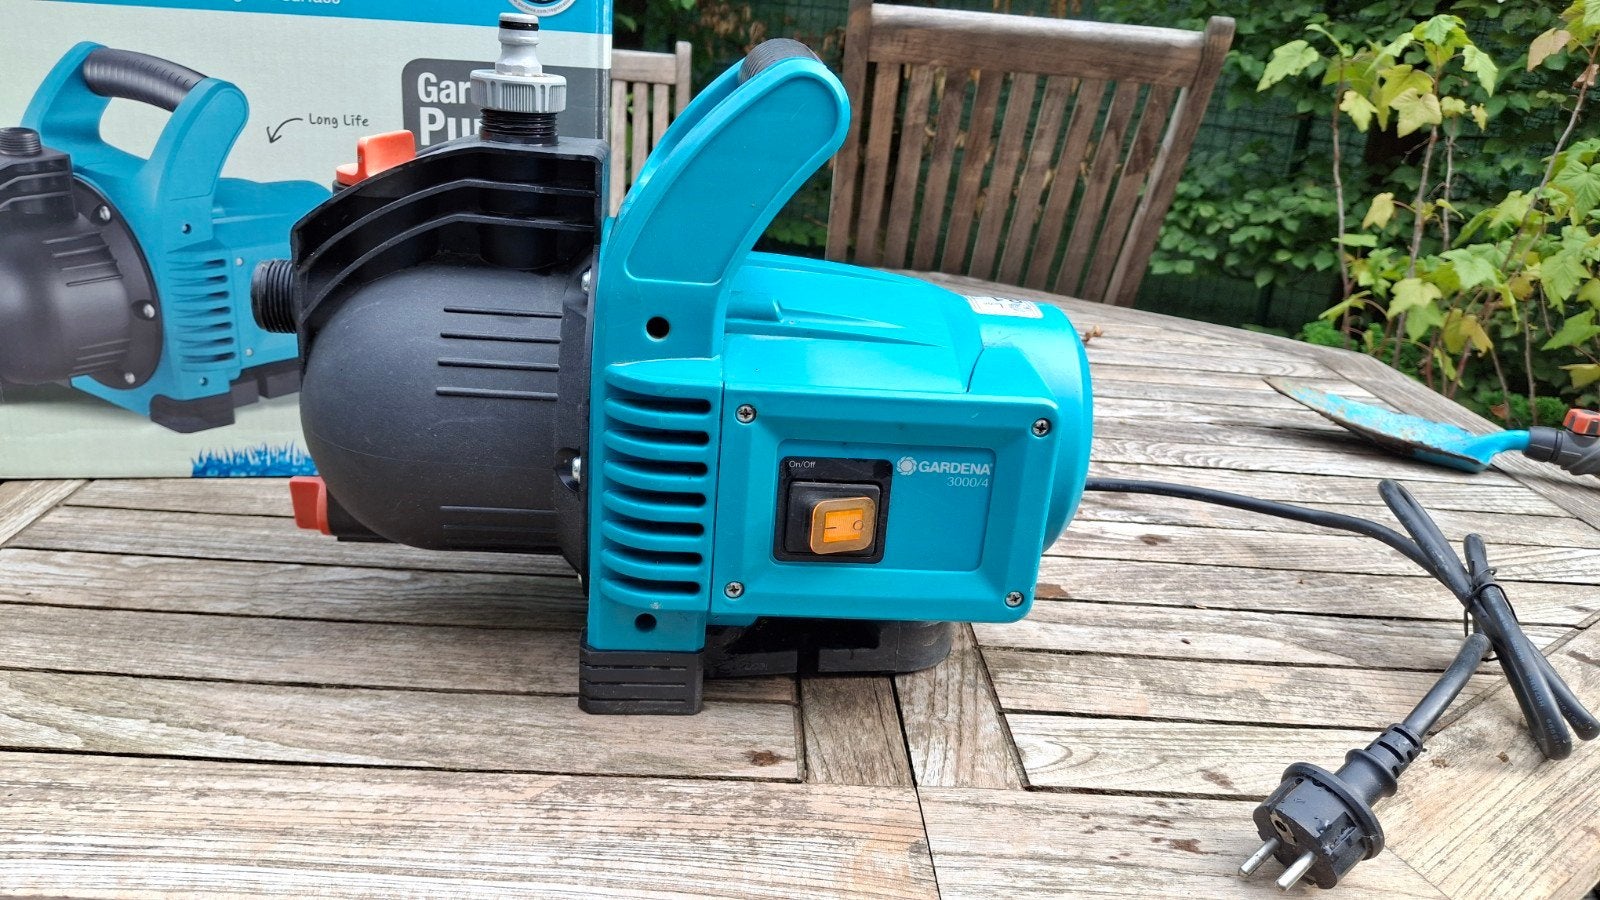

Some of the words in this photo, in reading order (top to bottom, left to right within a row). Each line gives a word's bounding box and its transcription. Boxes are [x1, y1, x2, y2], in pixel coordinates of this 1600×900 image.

[417, 71, 471, 104] Gar
[309, 112, 339, 129] Long
[343, 114, 370, 127] Life
[419, 106, 482, 146] Pu
[788, 460, 816, 469] On/Off
[918, 460, 991, 476] GARDENA
[947, 476, 989, 488] 3000/4
